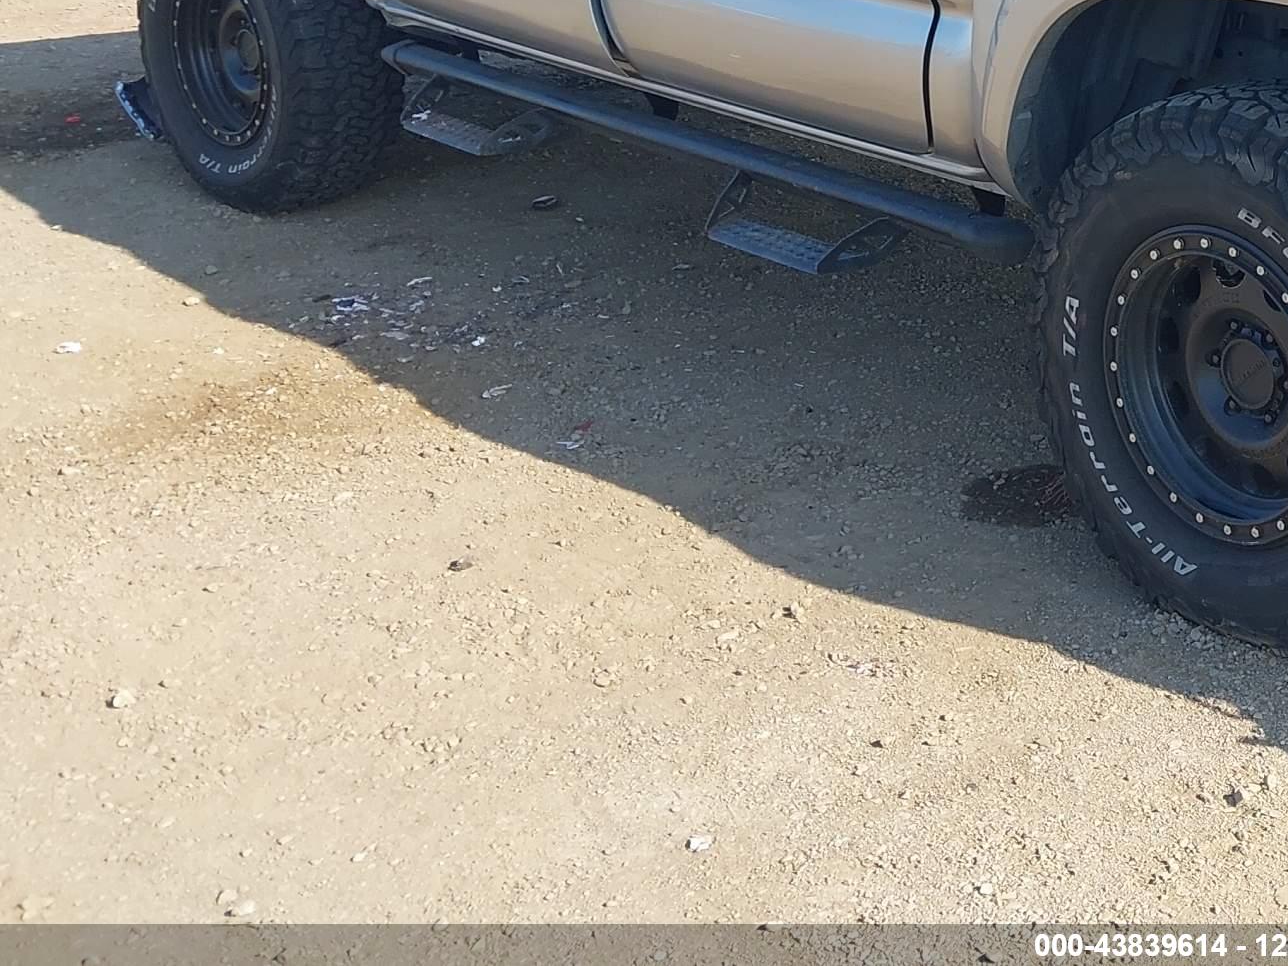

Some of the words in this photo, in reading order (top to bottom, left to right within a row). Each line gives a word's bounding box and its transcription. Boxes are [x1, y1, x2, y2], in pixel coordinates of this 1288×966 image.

[199, 154, 222, 174] T/A
[1062, 294, 1080, 358] T/A
[1068, 381, 1198, 576] All-Terrain
